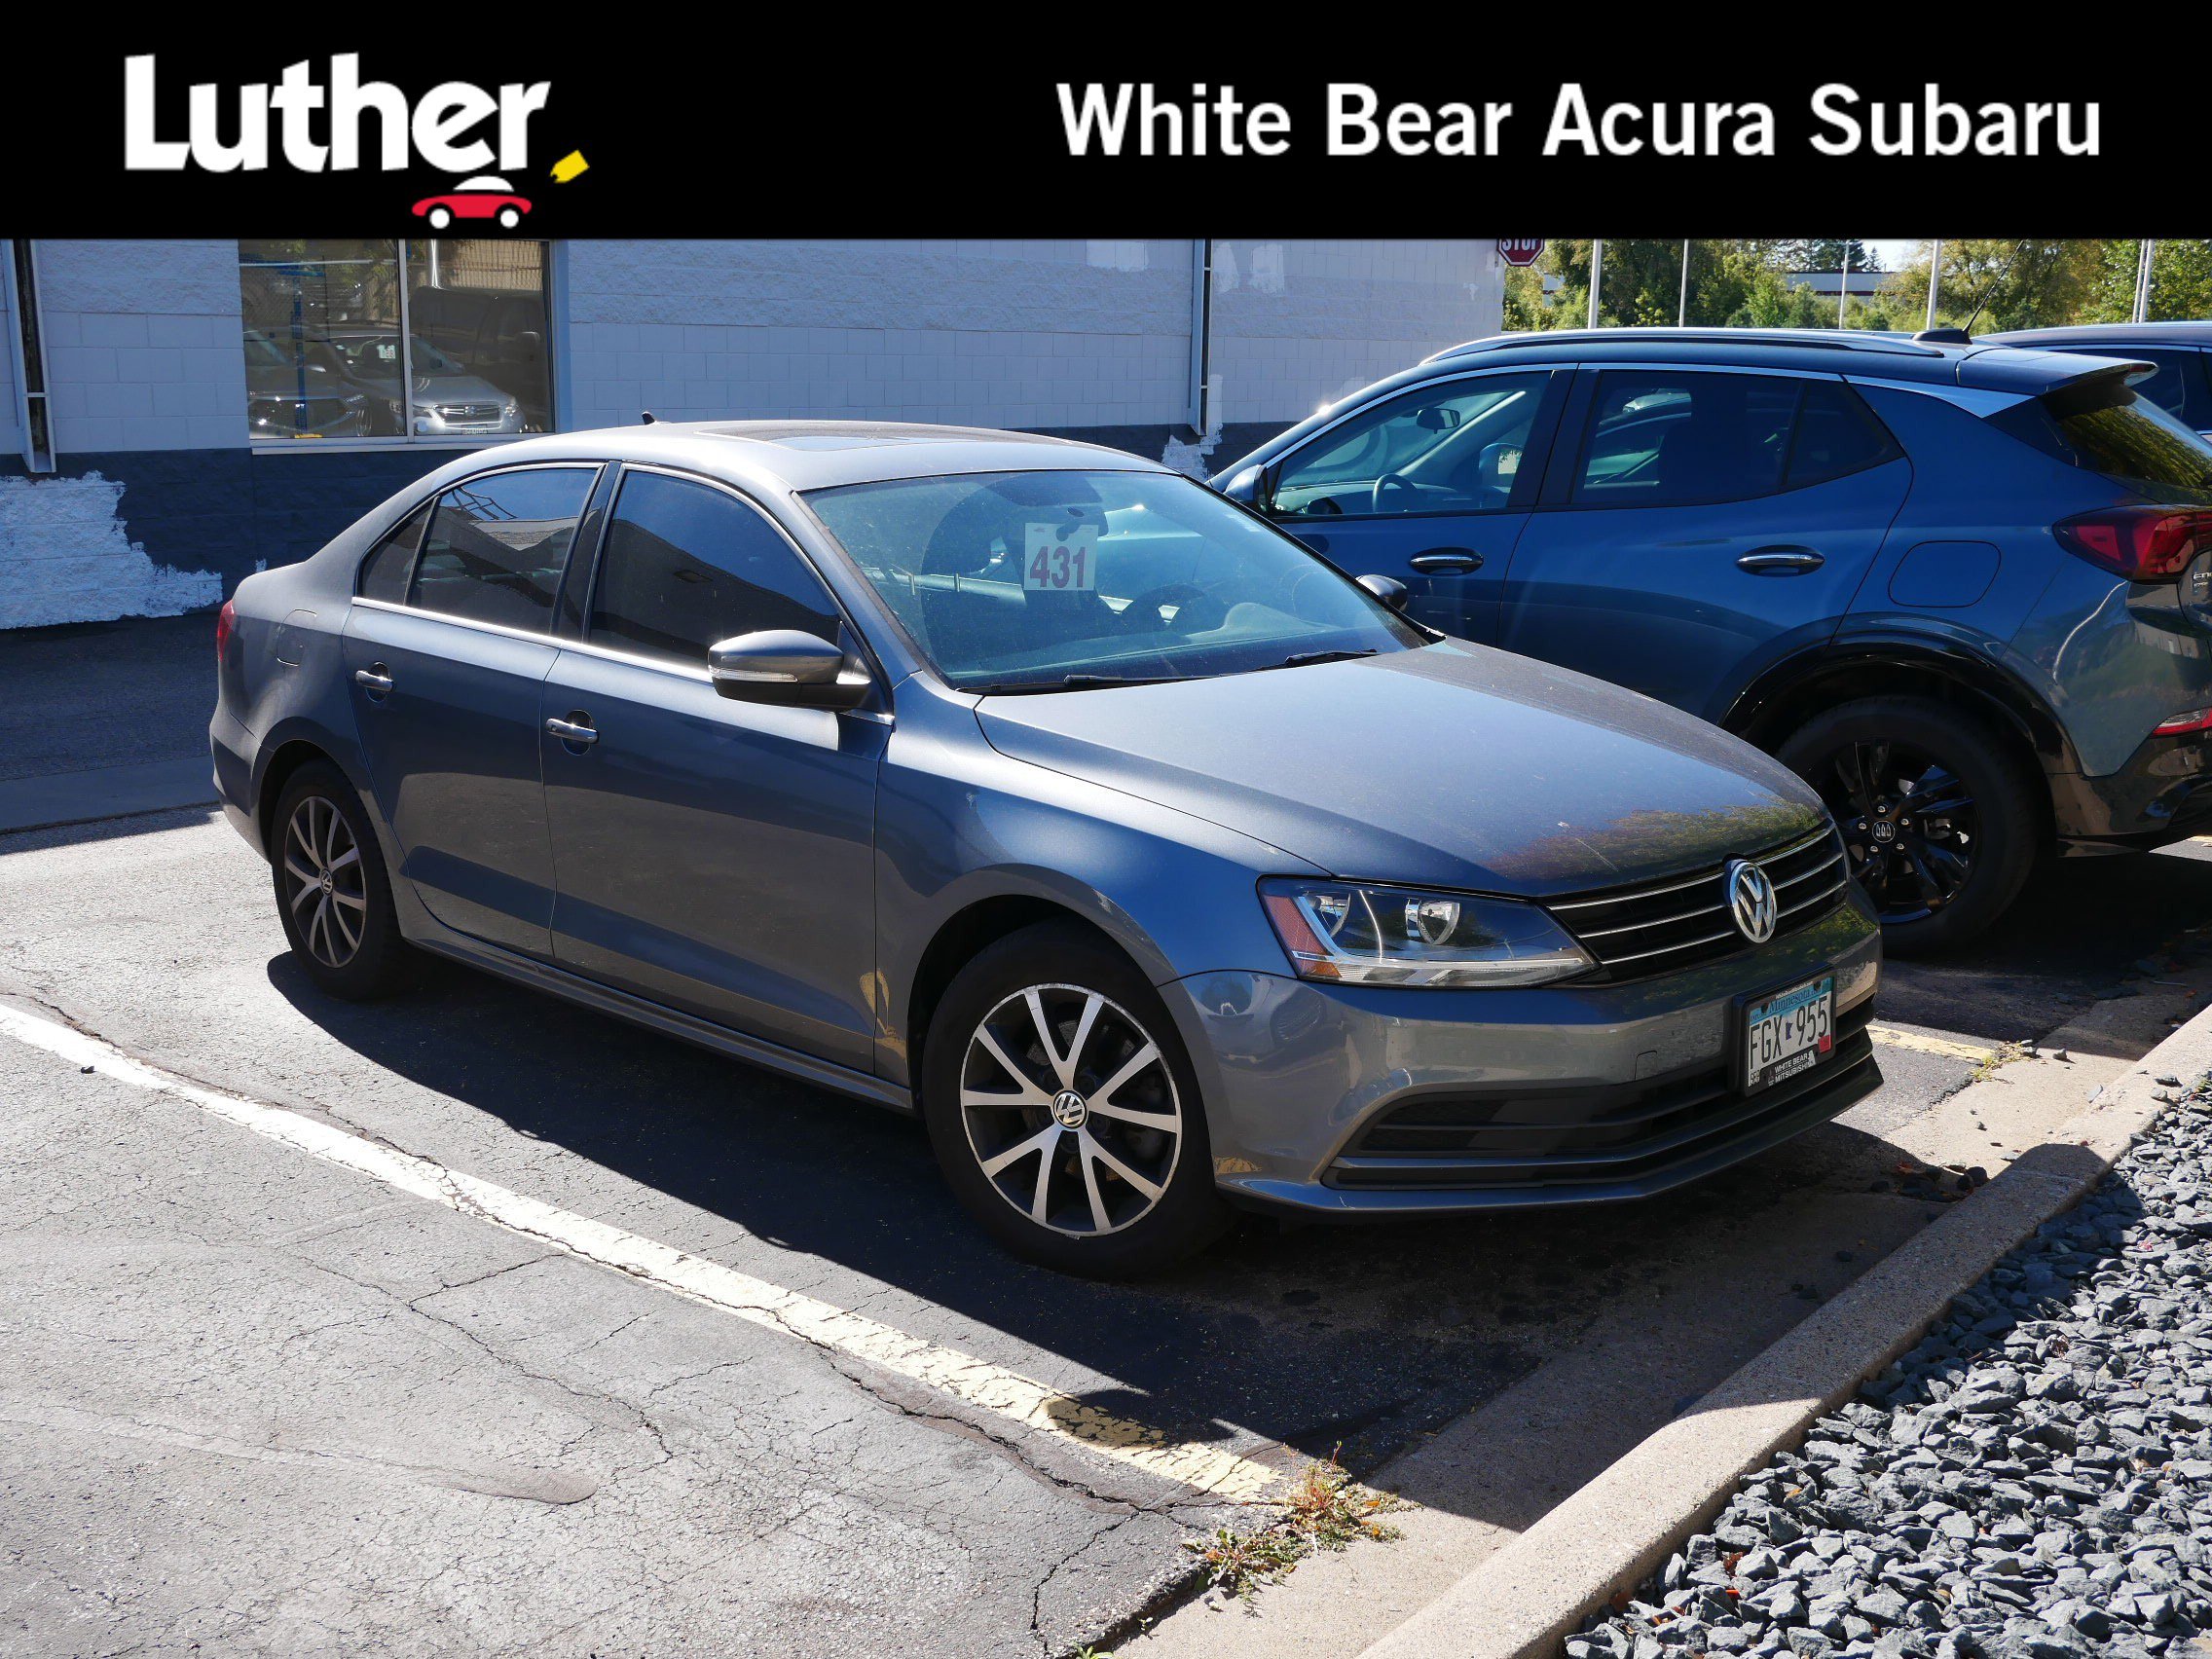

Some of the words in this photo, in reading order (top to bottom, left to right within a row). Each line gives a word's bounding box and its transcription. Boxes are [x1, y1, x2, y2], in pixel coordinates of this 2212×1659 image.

[1029, 545, 1087, 589] 431
[1750, 1014, 1784, 1070] FGX
[1796, 996, 1827, 1047] 955
